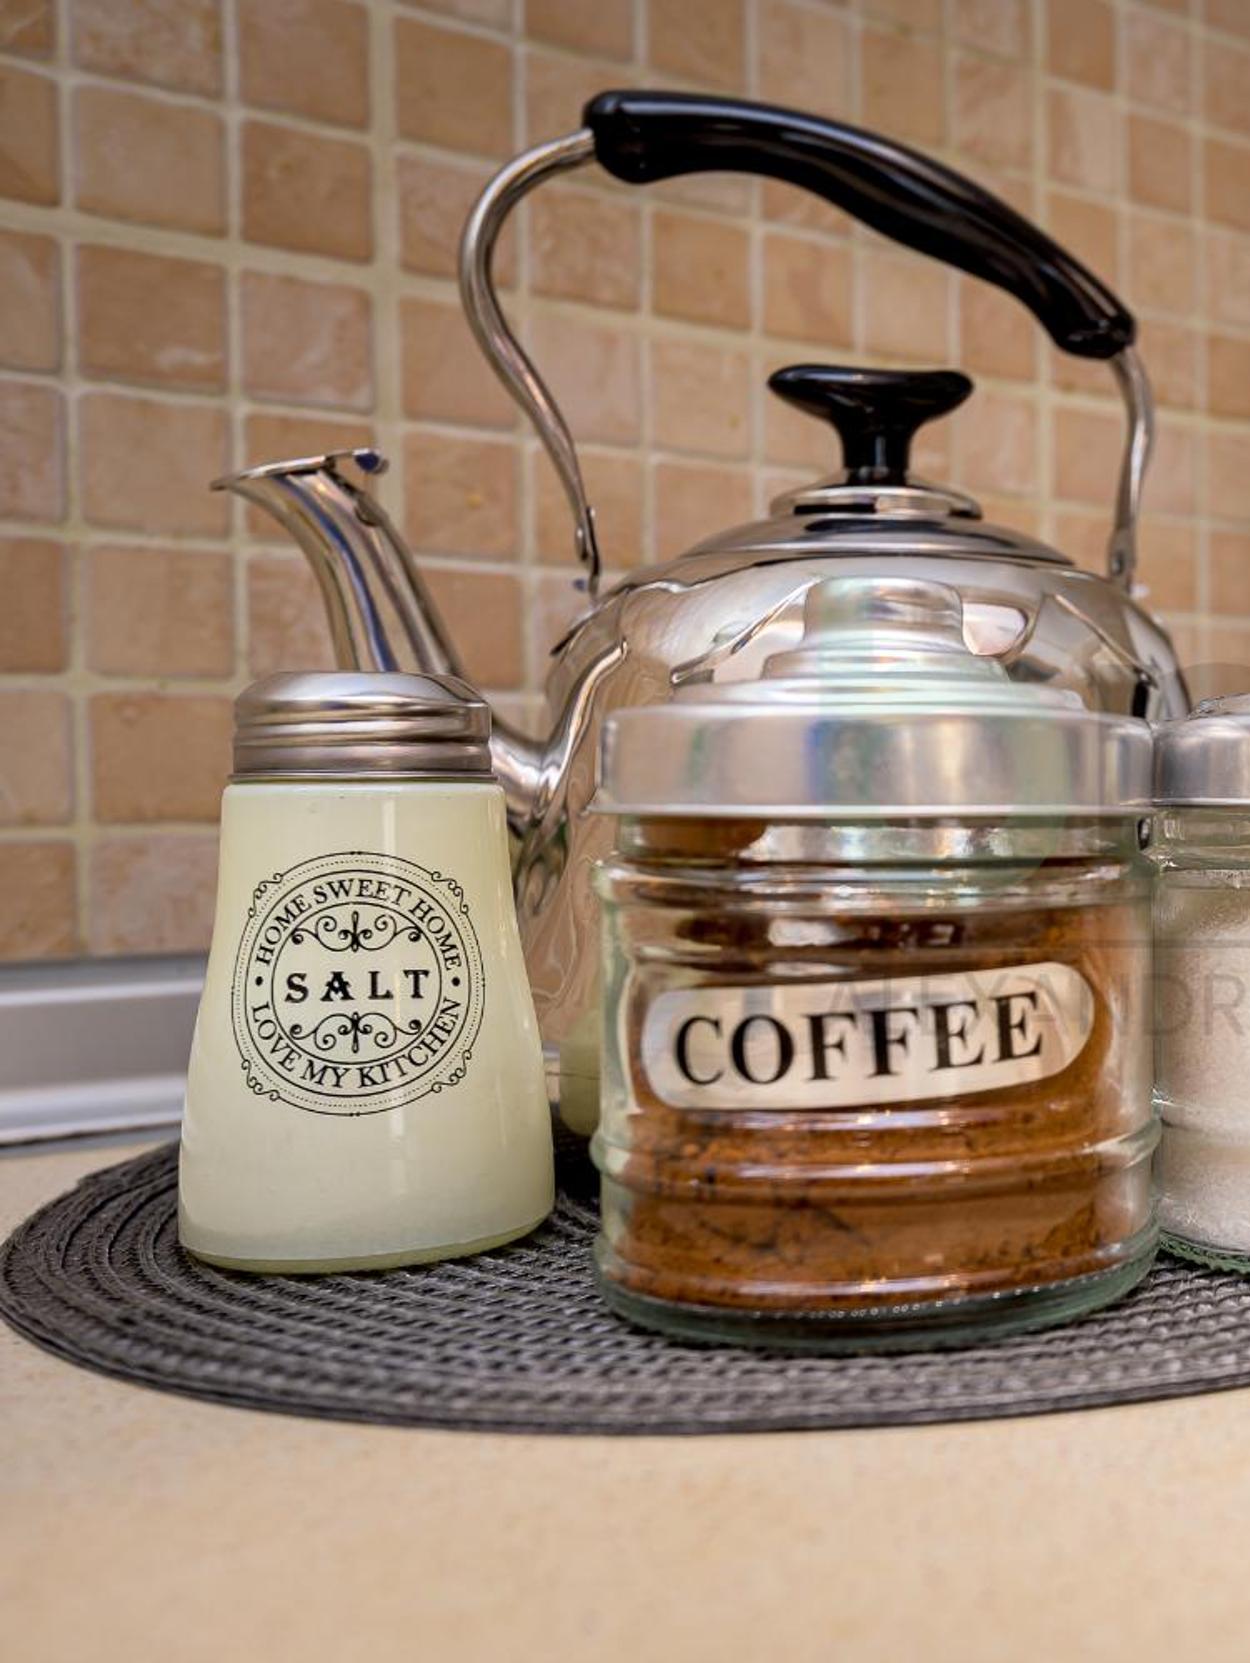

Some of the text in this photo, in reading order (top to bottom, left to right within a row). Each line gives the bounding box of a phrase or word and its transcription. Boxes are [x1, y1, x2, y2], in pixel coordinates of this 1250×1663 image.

[255, 878, 462, 971] HOME SWEET HOME
[284, 969, 430, 1004] SALT
[251, 996, 462, 1089] LOVE MY KITCHEN
[674, 990, 1044, 1087] COFFEE
